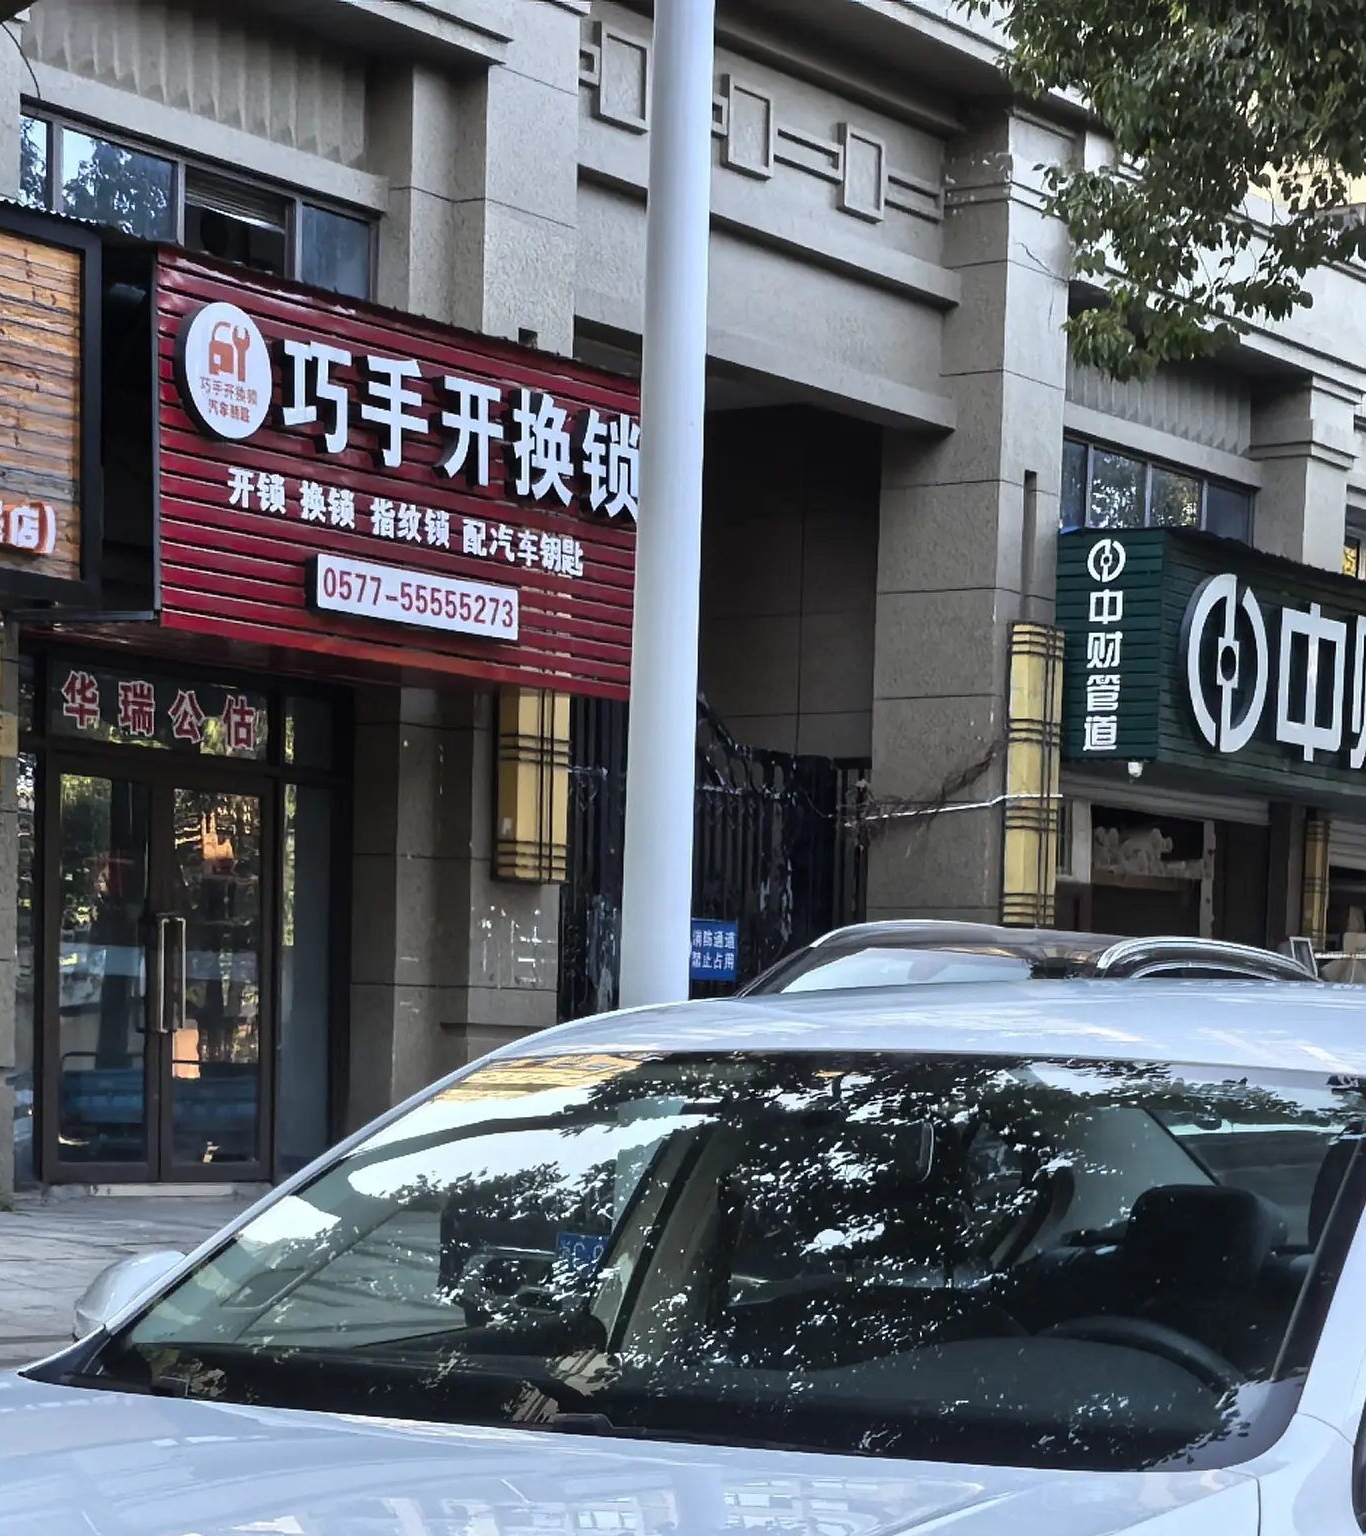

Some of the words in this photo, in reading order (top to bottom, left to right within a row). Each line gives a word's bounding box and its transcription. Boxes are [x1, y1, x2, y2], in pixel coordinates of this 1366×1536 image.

[281, 339, 640, 523] 巧手开换锁
[227, 467, 286, 515] 开锁
[299, 480, 355, 530] 换锁
[370, 496, 450, 550] 指纹锁
[462, 518, 584, 577] 配汽车钥匙
[323, 566, 515, 629] 0577-55555273
[61, 669, 259, 750] 华瑞公估
[1083, 588, 1123, 751] 中财管道
[691, 951, 736, 971] 禁止占用
[692, 929, 736, 949] 消防通道
